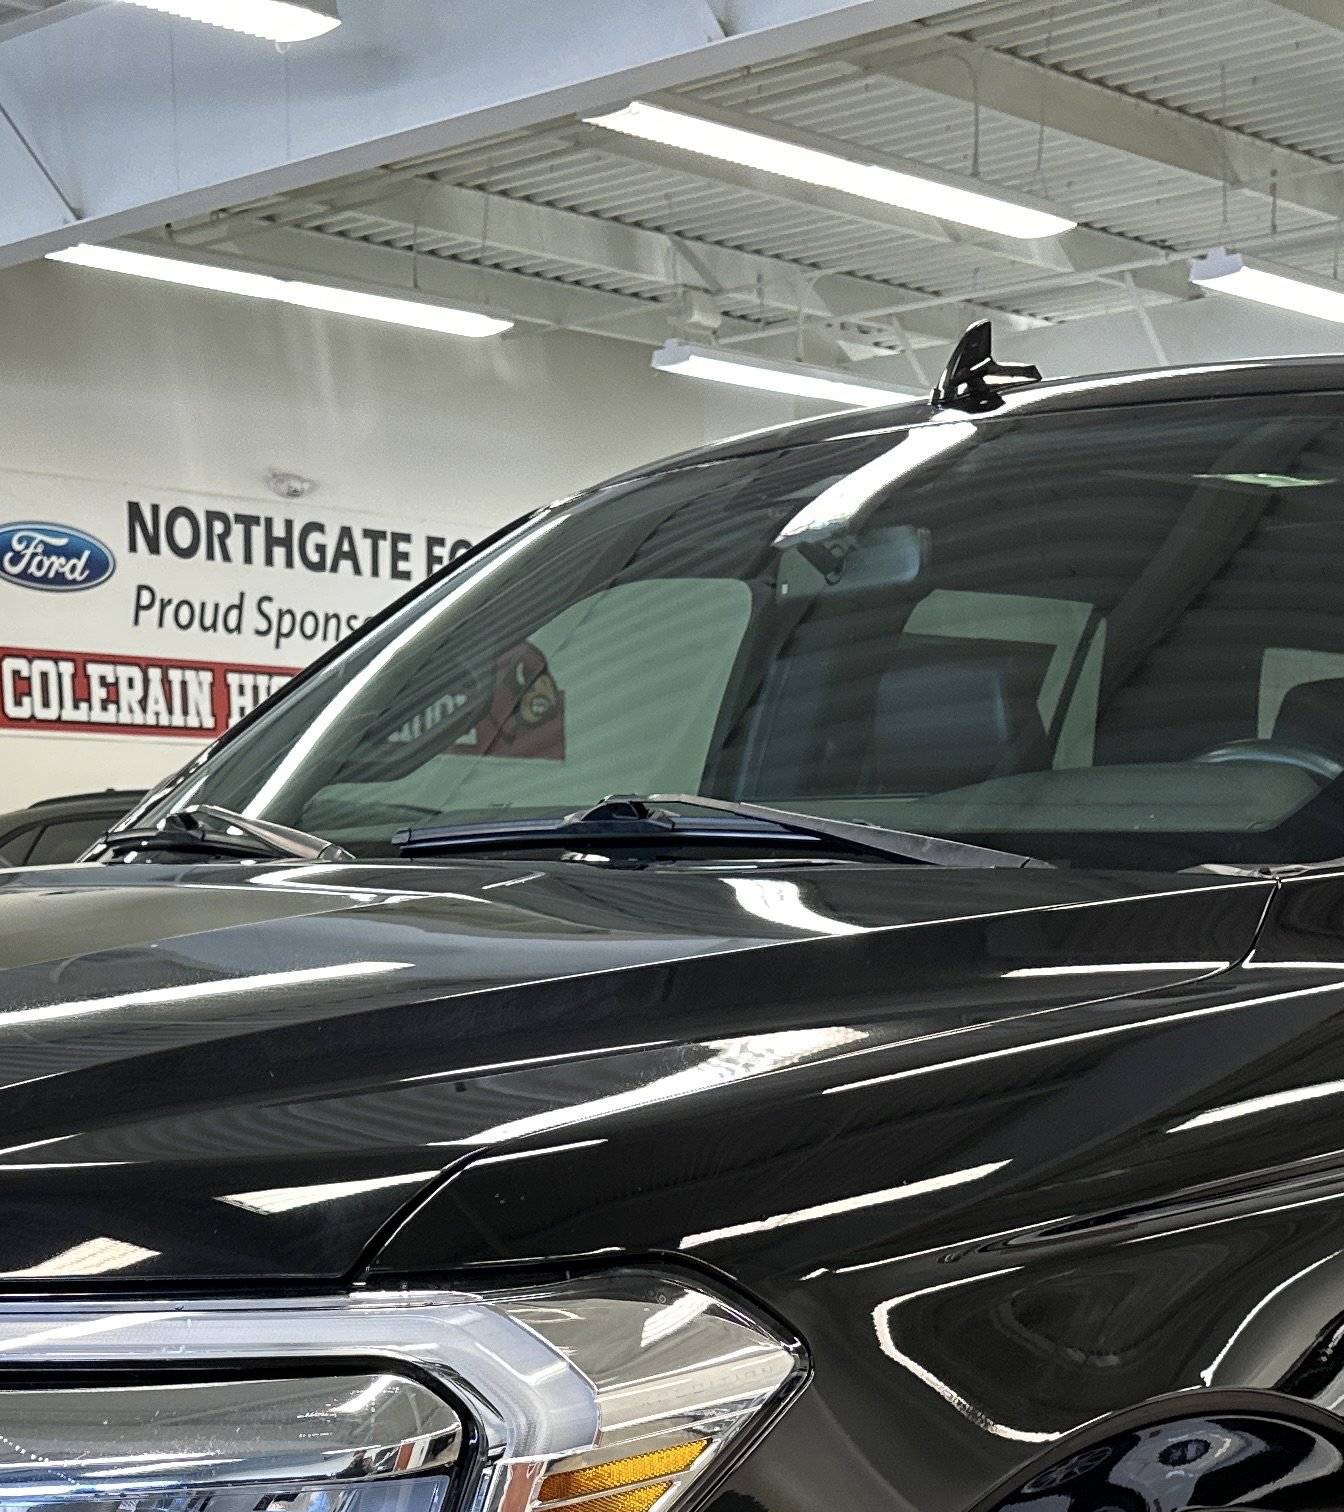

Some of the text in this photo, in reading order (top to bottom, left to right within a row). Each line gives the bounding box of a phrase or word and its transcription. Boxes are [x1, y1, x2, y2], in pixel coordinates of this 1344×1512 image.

[2, 530, 91, 582] Ford
[127, 500, 412, 583] NORTHGATE
[133, 585, 245, 637] Proud
[0, 654, 216, 730] COLERAIN
